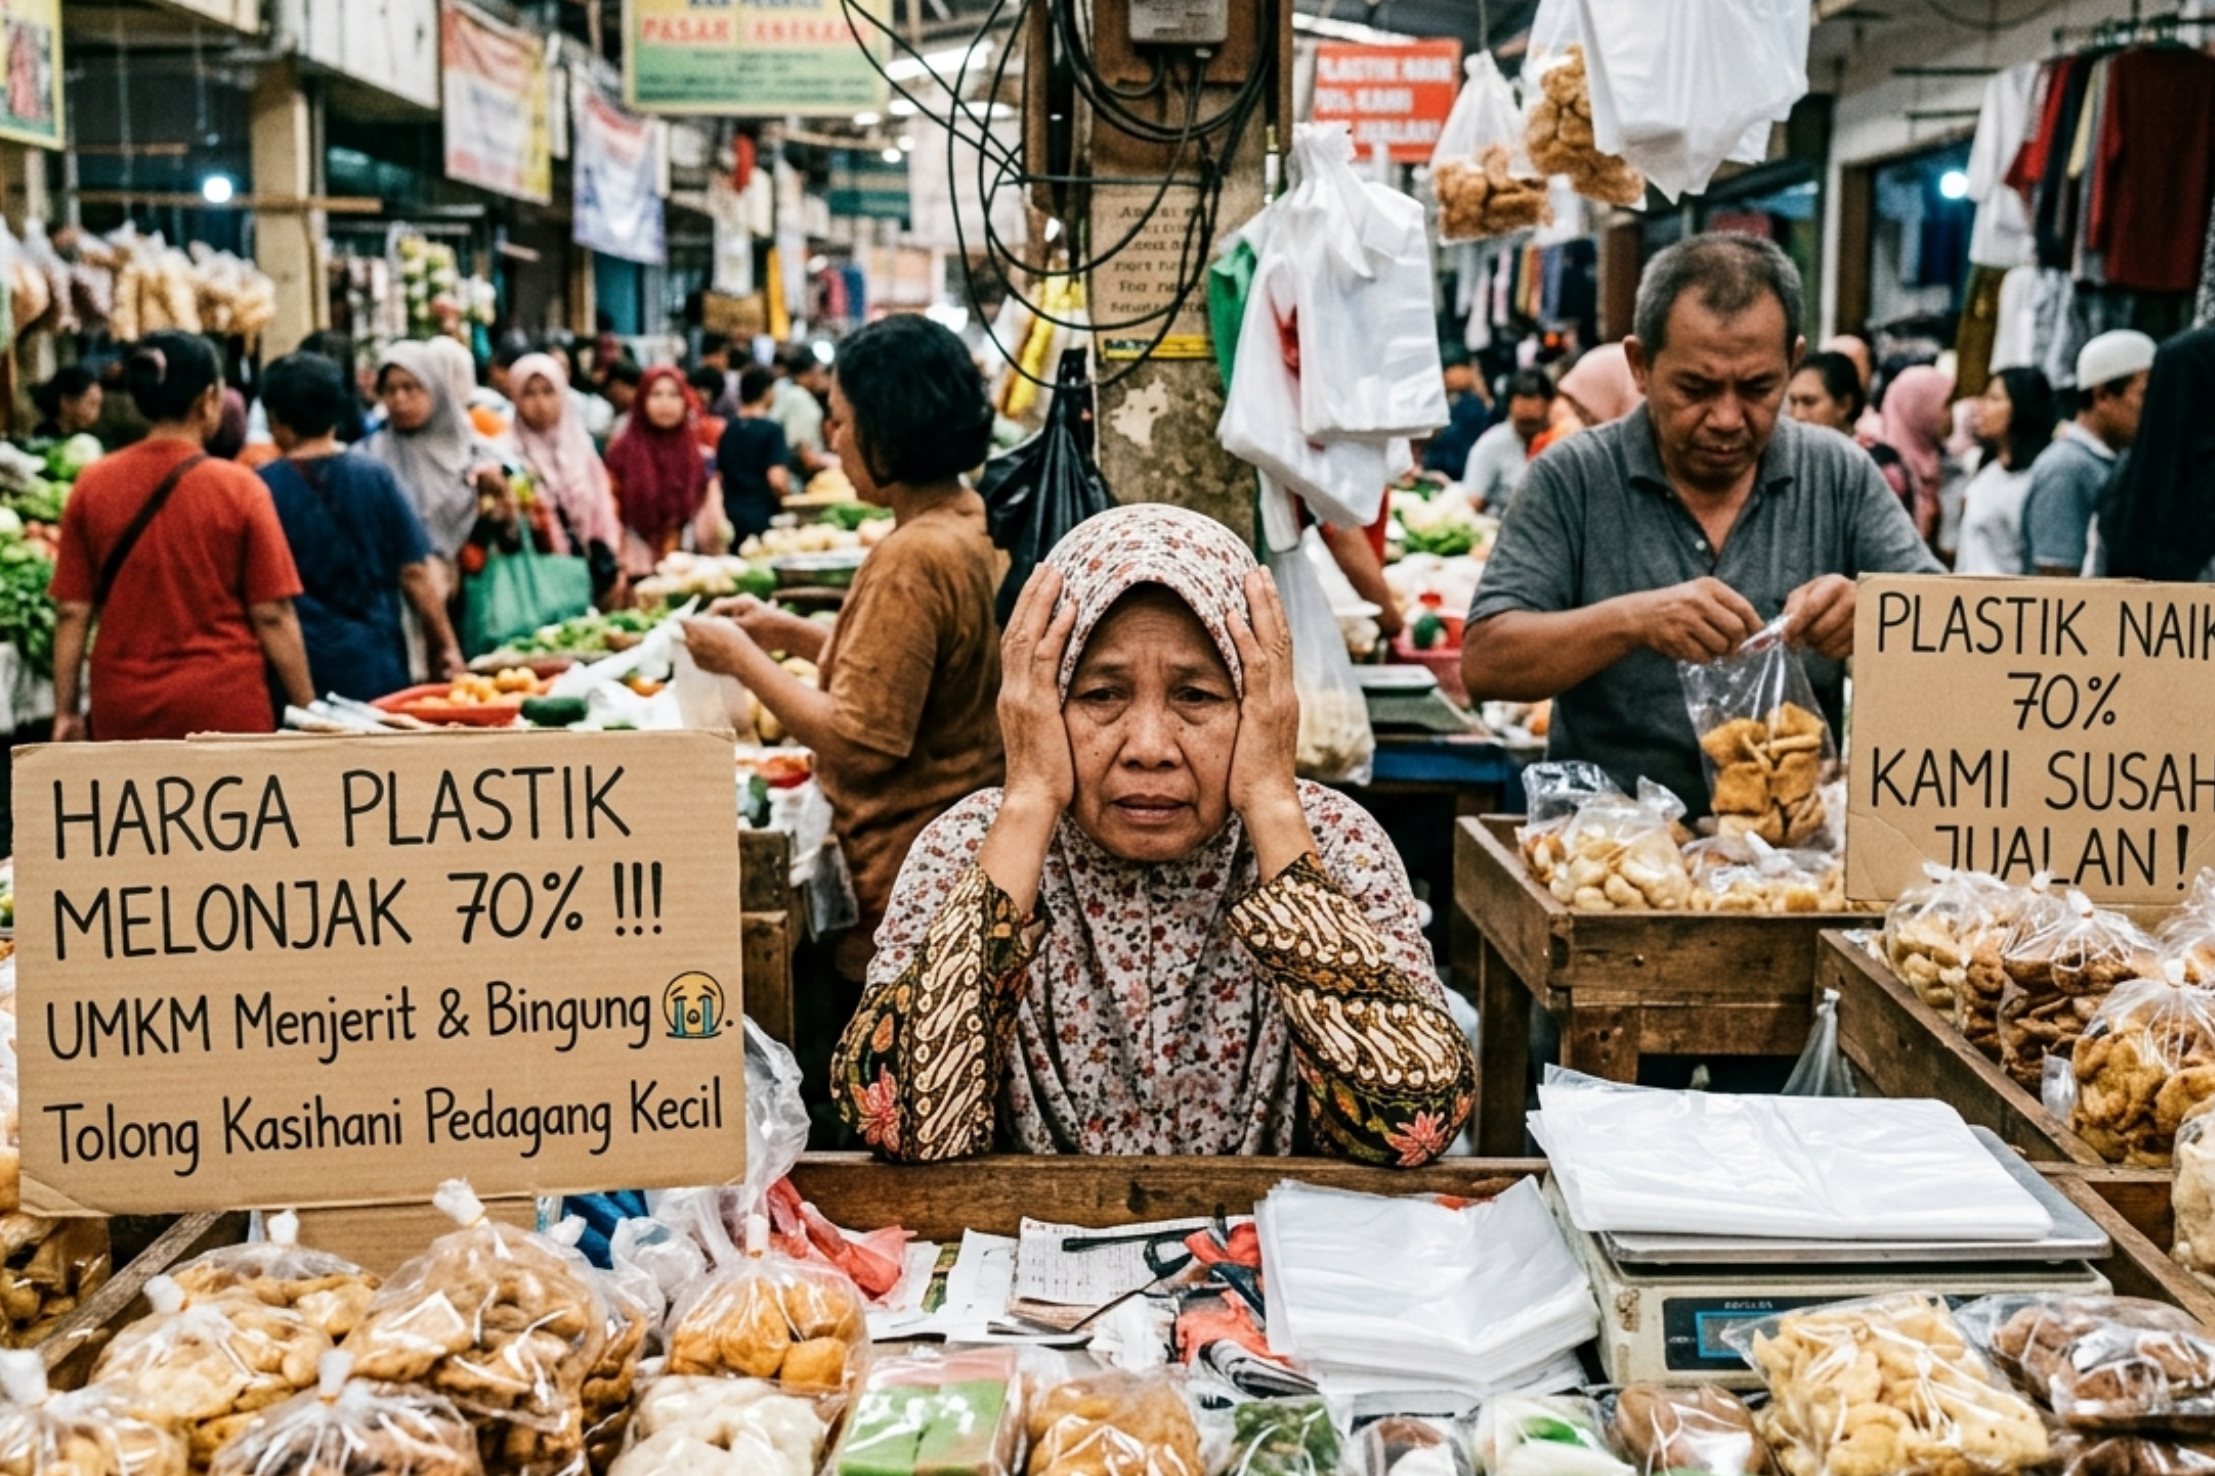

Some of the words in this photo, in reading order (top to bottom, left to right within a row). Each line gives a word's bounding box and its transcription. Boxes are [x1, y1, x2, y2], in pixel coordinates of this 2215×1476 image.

[1878, 591, 2088, 657] PLASTIK
[2007, 672, 2121, 731] 70%
[53, 774, 300, 860] HARGA
[342, 765, 631, 848] PLASTIK
[1871, 746, 2009, 809] KAMI
[2044, 750, 2215, 813] SUSAH
[54, 877, 413, 961] MELONJAK
[447, 865, 584, 945] 70%
[613, 861, 663, 937] !!!
[46, 994, 211, 1061] UMKM
[235, 985, 417, 1065] Menjerit
[437, 987, 470, 1040] &
[486, 980, 652, 1053] Bingung
[42, 1102, 200, 1178] Tolong
[222, 1094, 403, 1155] Kasihani
[425, 1086, 611, 1159] Pedagang
[630, 1075, 722, 1134] Kecil
